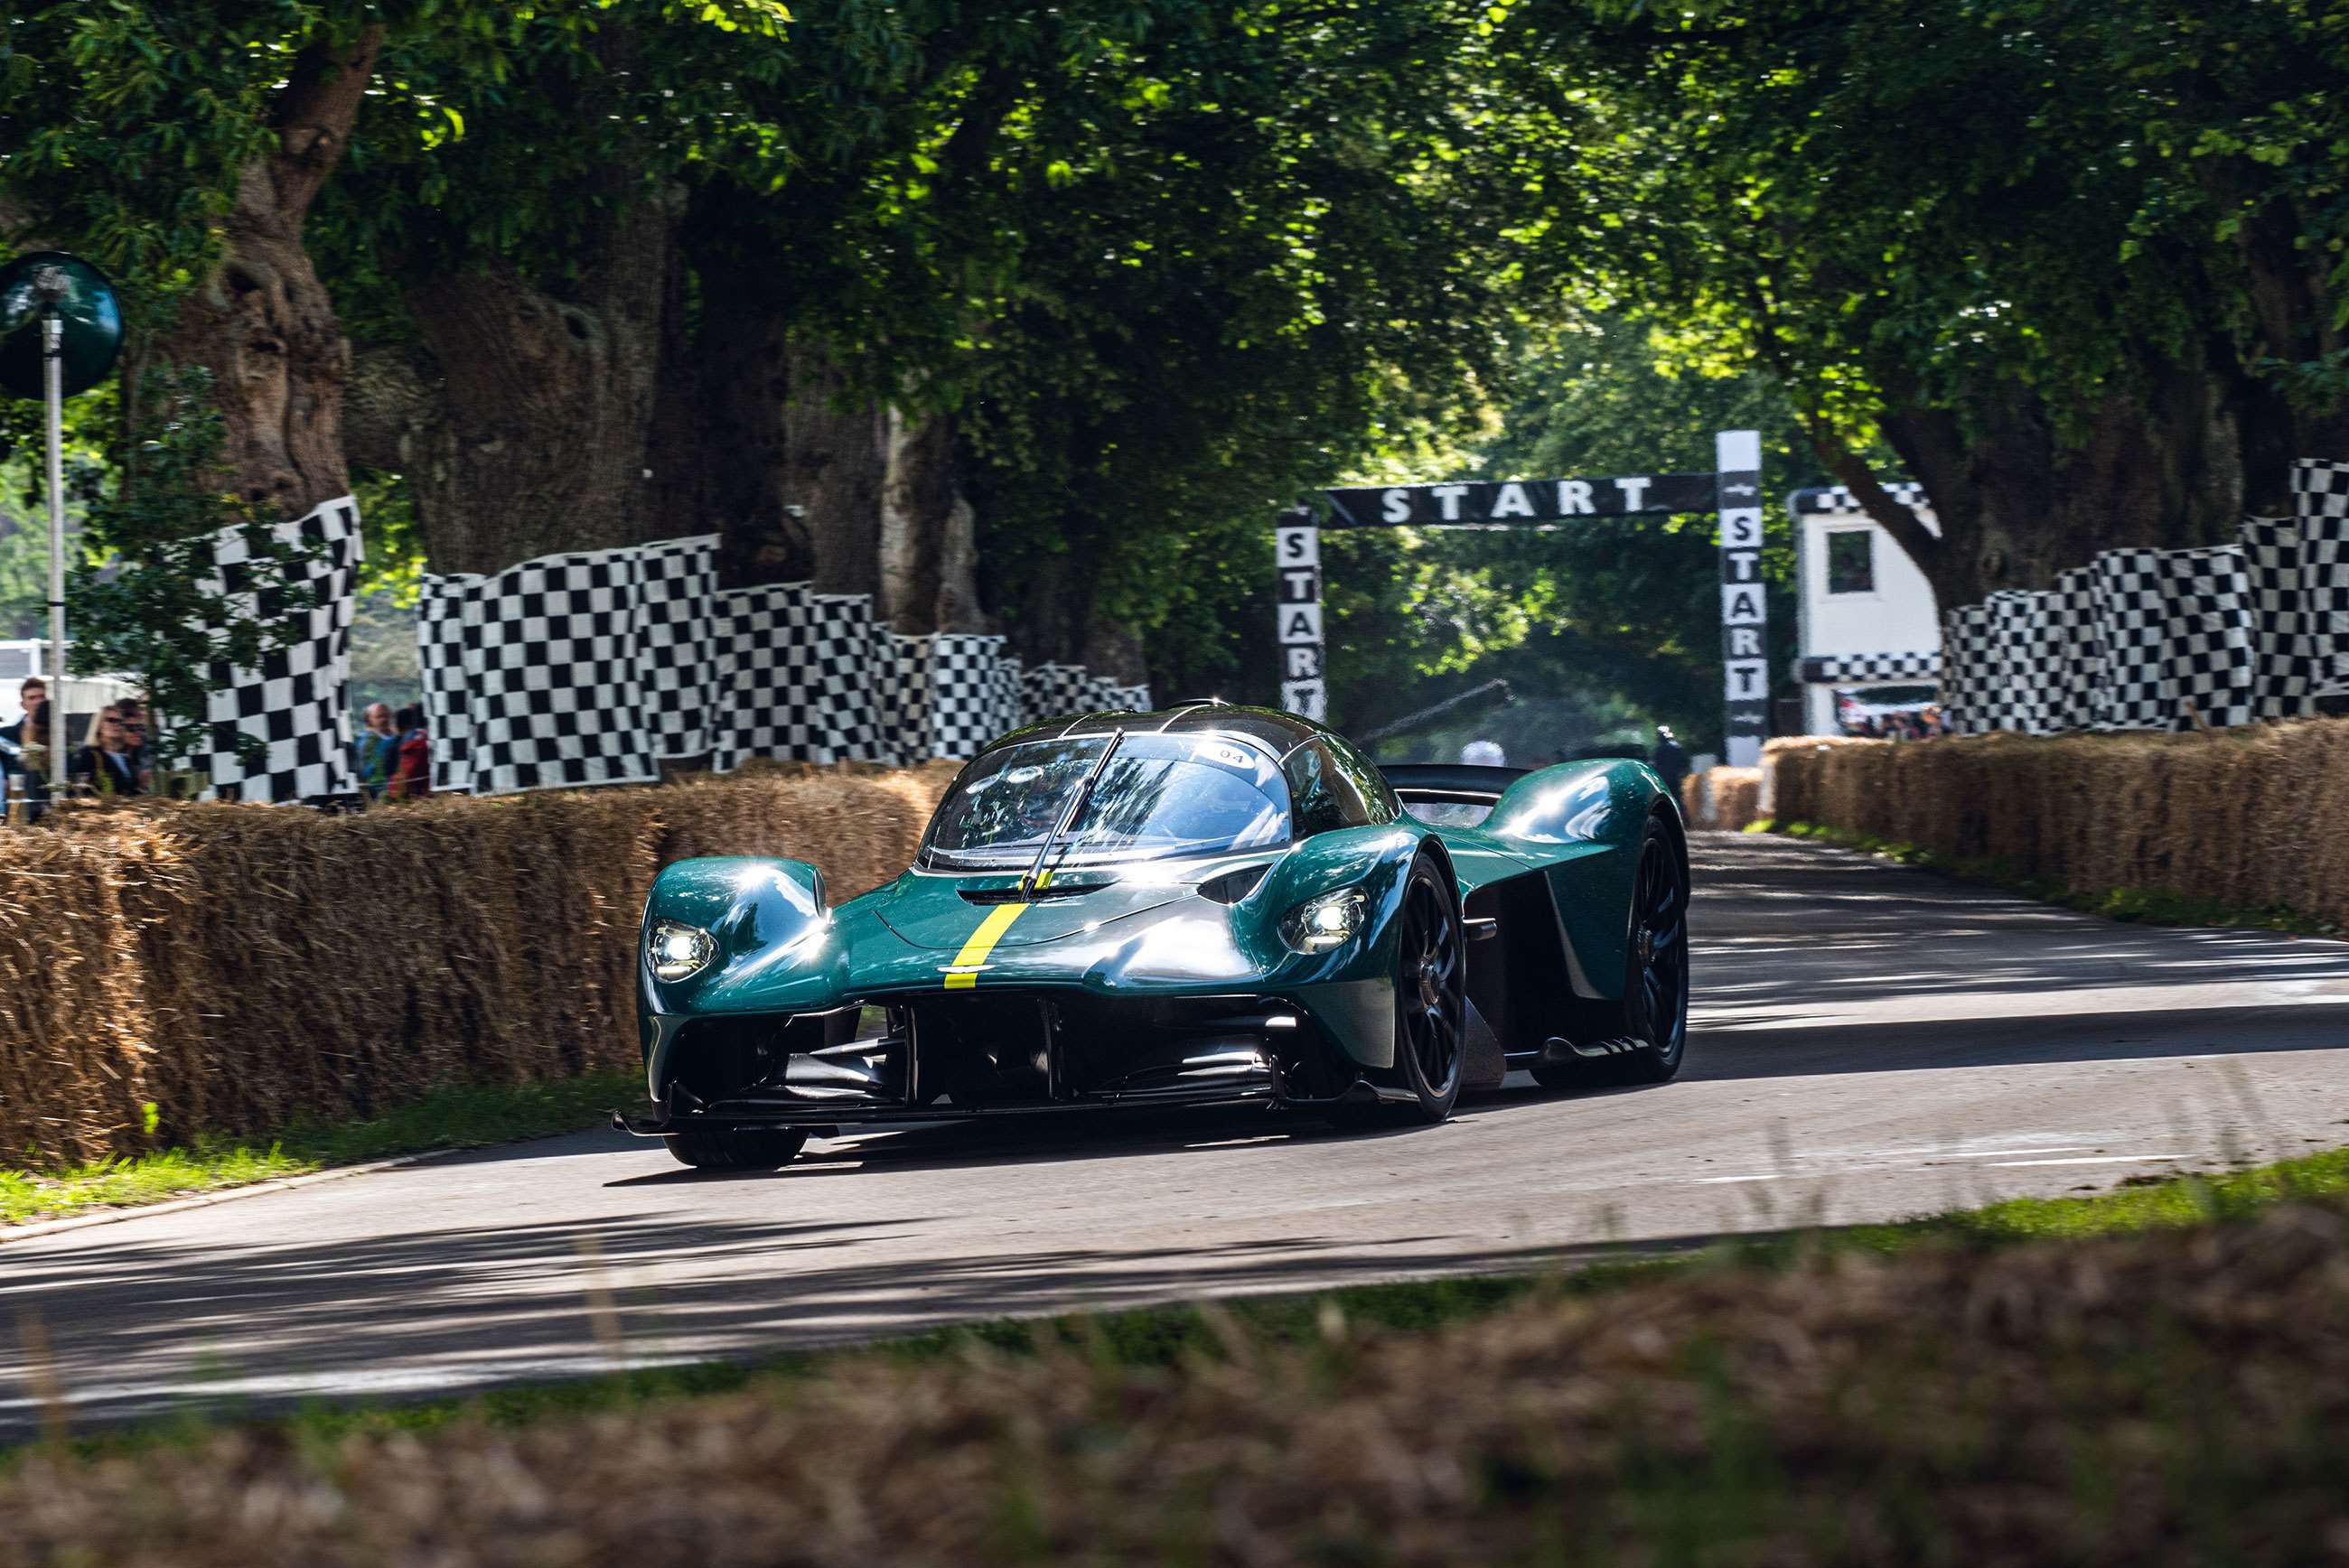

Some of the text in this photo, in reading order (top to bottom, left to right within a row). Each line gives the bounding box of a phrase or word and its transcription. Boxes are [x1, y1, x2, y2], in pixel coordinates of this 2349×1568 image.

[1381, 477, 1652, 523] START
[1284, 532, 1317, 716] START
[1727, 516, 1760, 693] START
